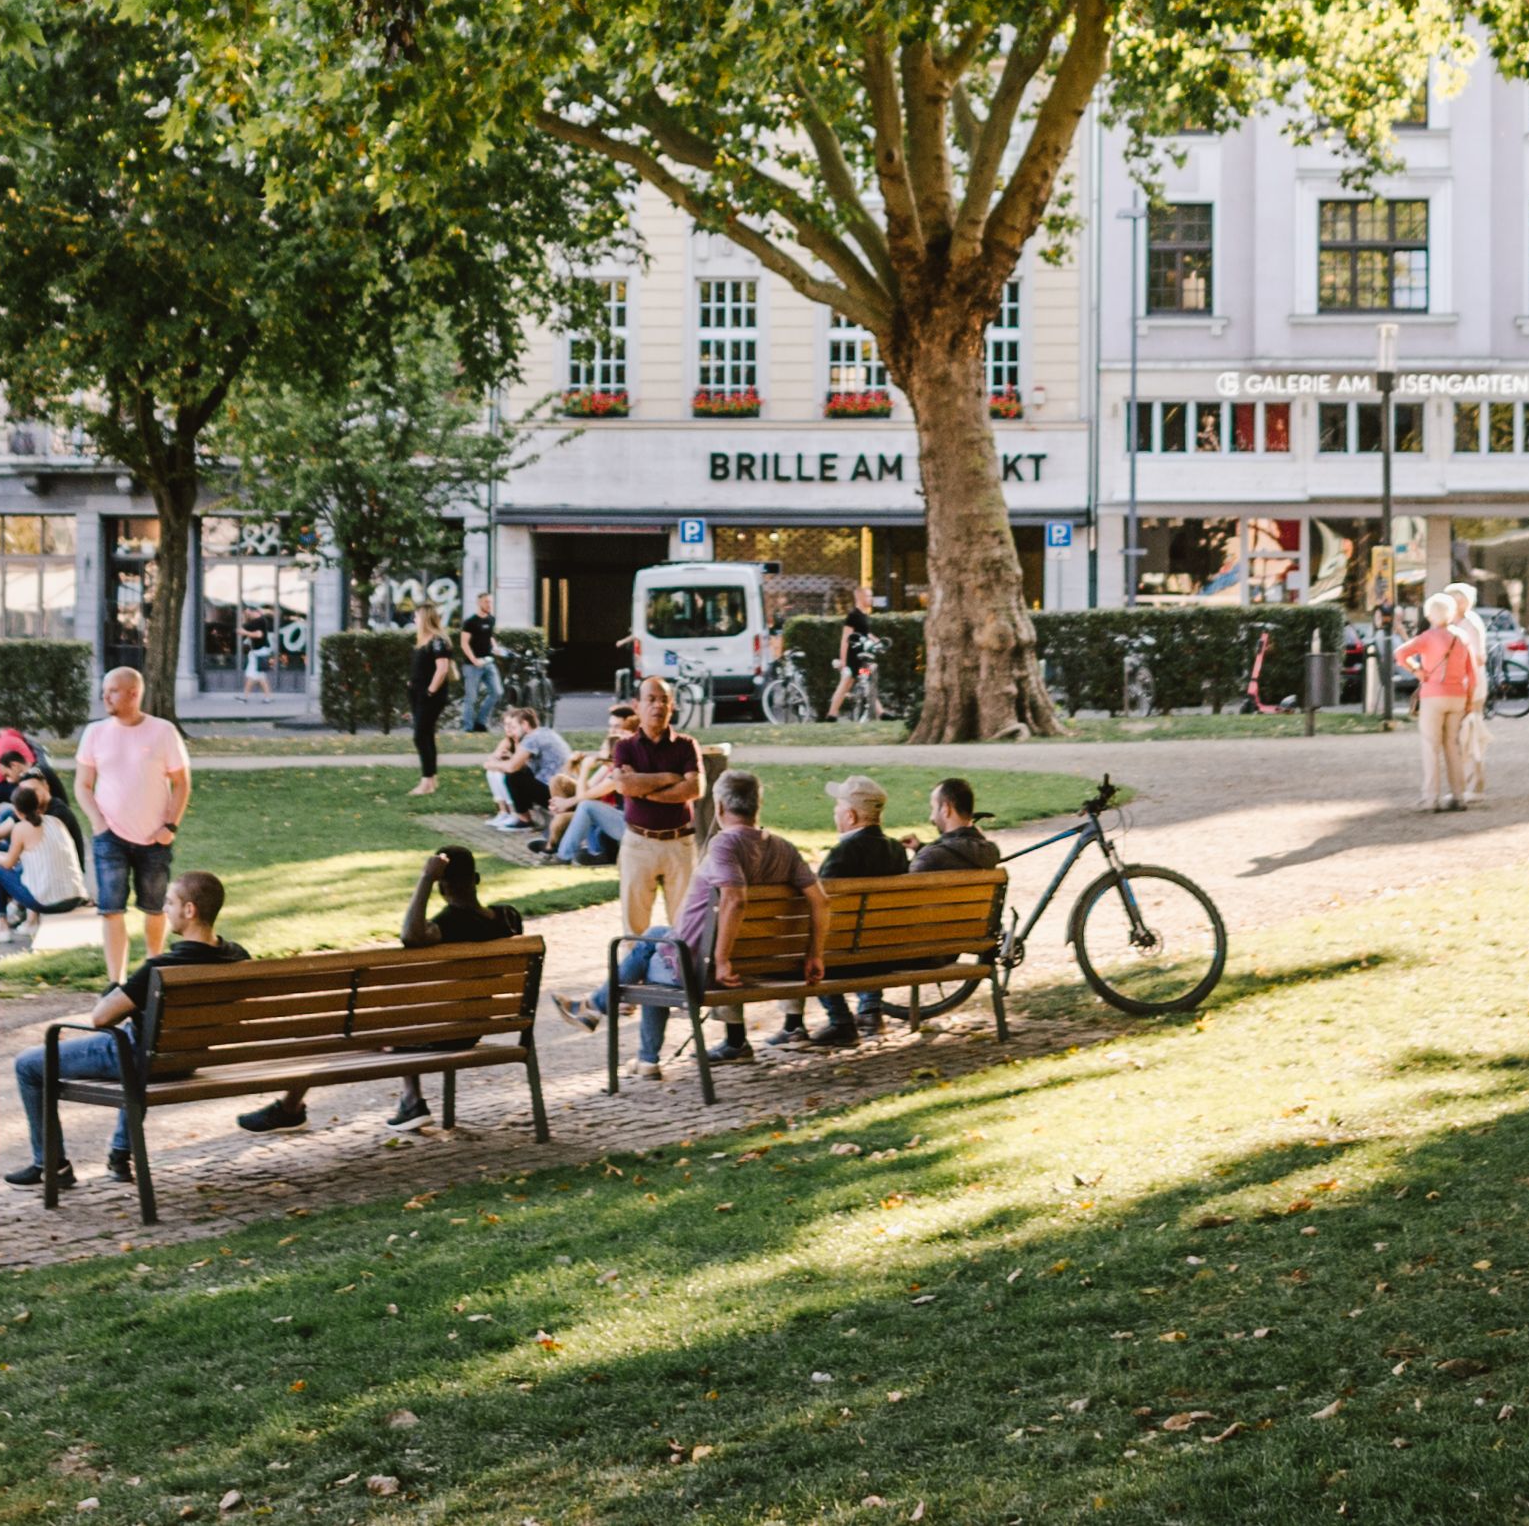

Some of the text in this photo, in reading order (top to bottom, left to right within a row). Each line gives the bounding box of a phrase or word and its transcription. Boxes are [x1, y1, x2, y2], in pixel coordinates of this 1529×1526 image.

[1244, 374, 1529, 395] GALERIE AM ISENGARTEN
[709, 452, 904, 482] BRILLE AM
